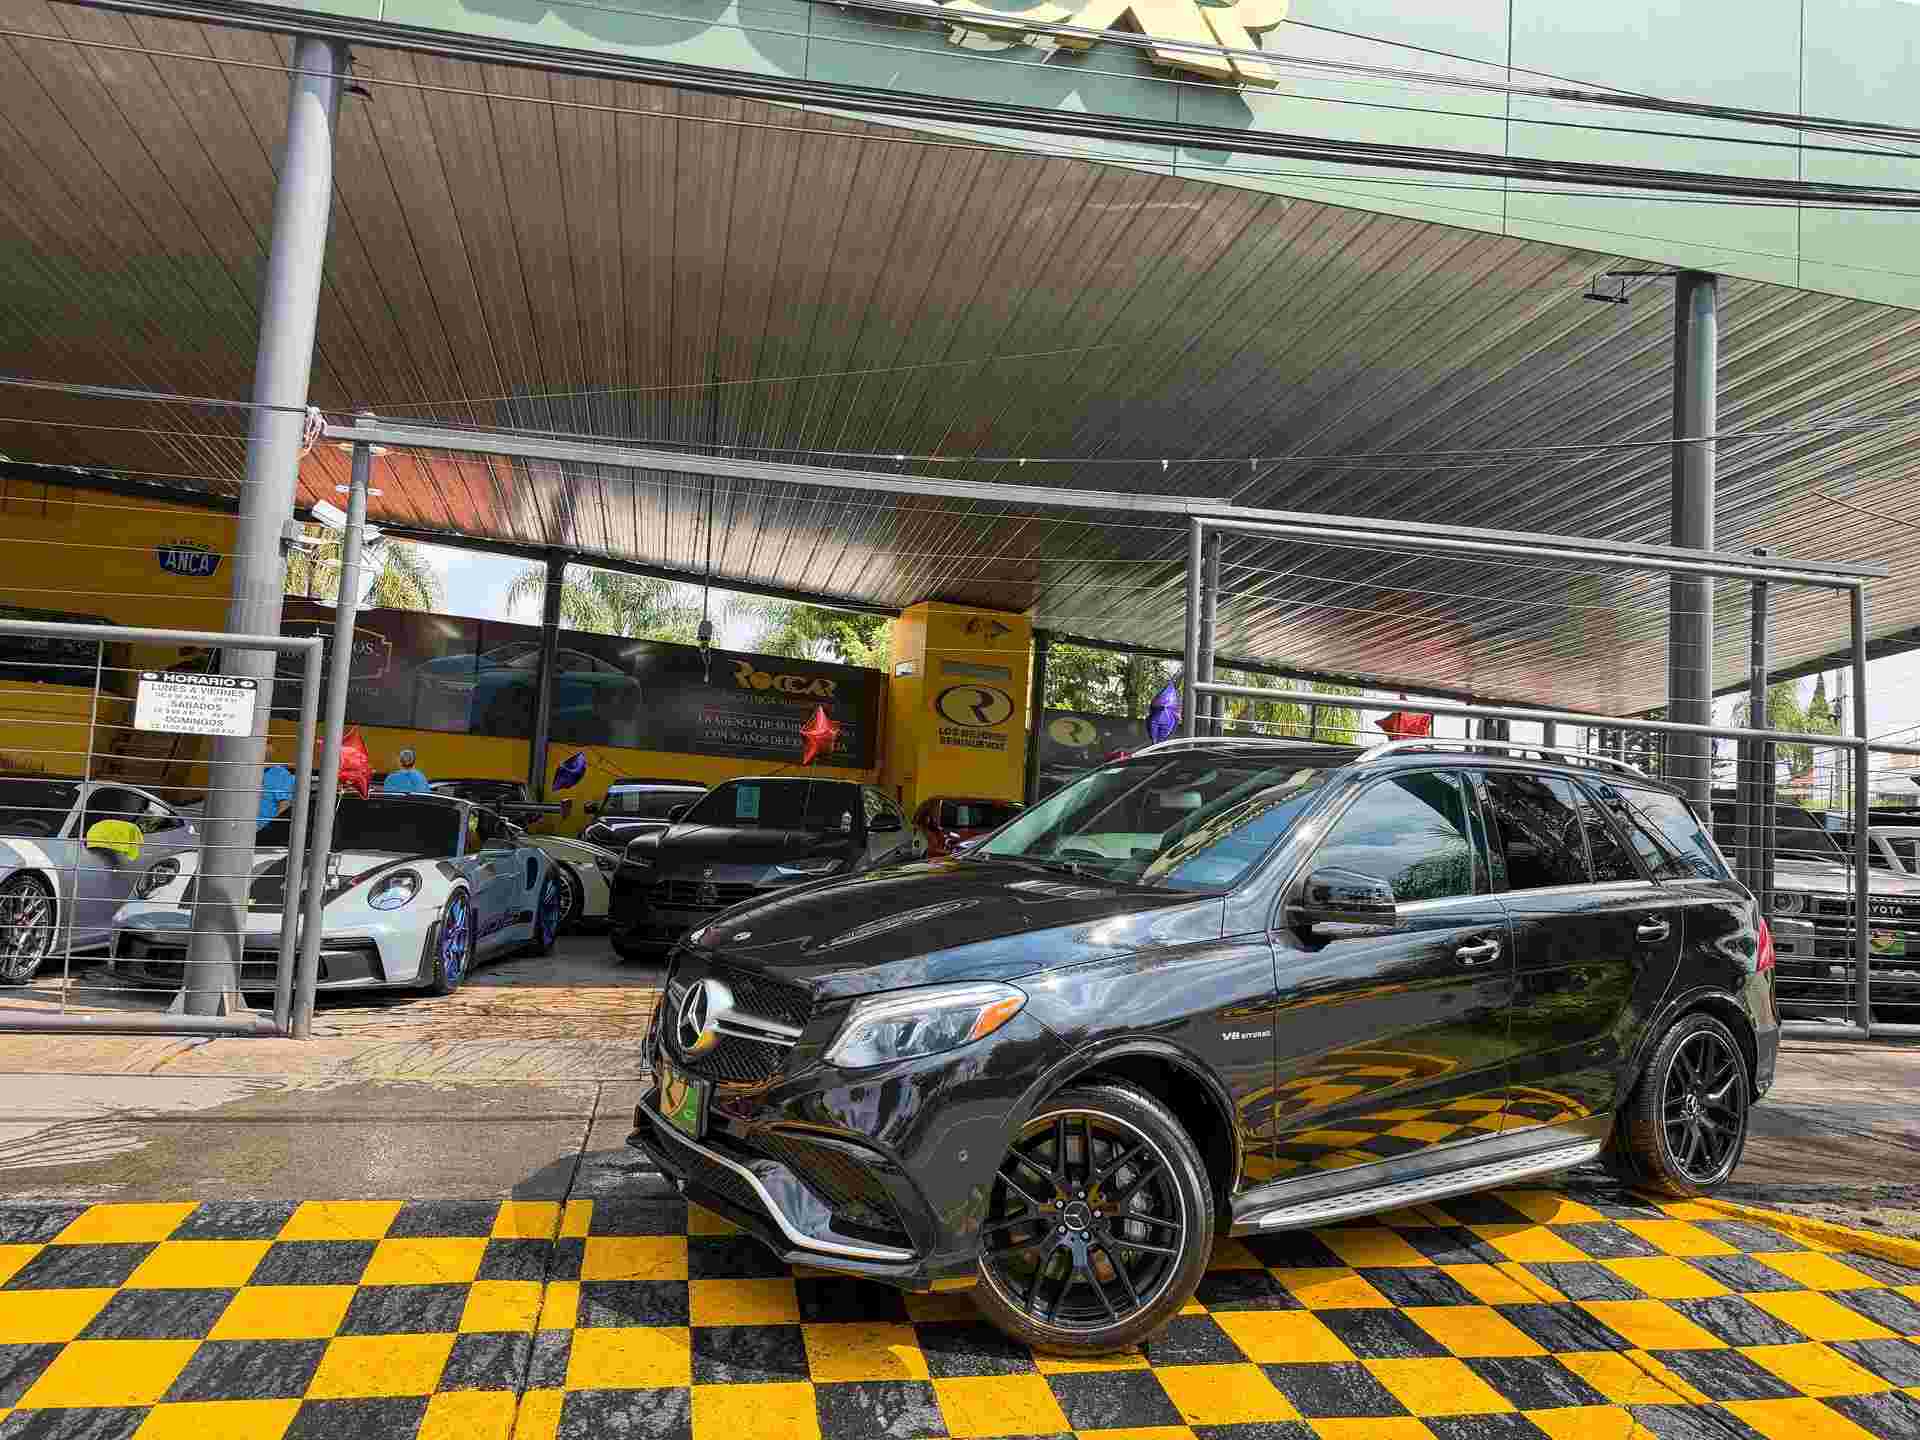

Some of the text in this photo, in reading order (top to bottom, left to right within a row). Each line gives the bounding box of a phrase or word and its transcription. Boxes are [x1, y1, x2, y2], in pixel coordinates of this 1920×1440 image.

[164, 551, 209, 572] ANCA
[163, 672, 236, 687] HORARIO
[152, 682, 187, 694] LUNES
[200, 687, 245, 697] VIERNES
[164, 715, 225, 727] DOMINGOS
